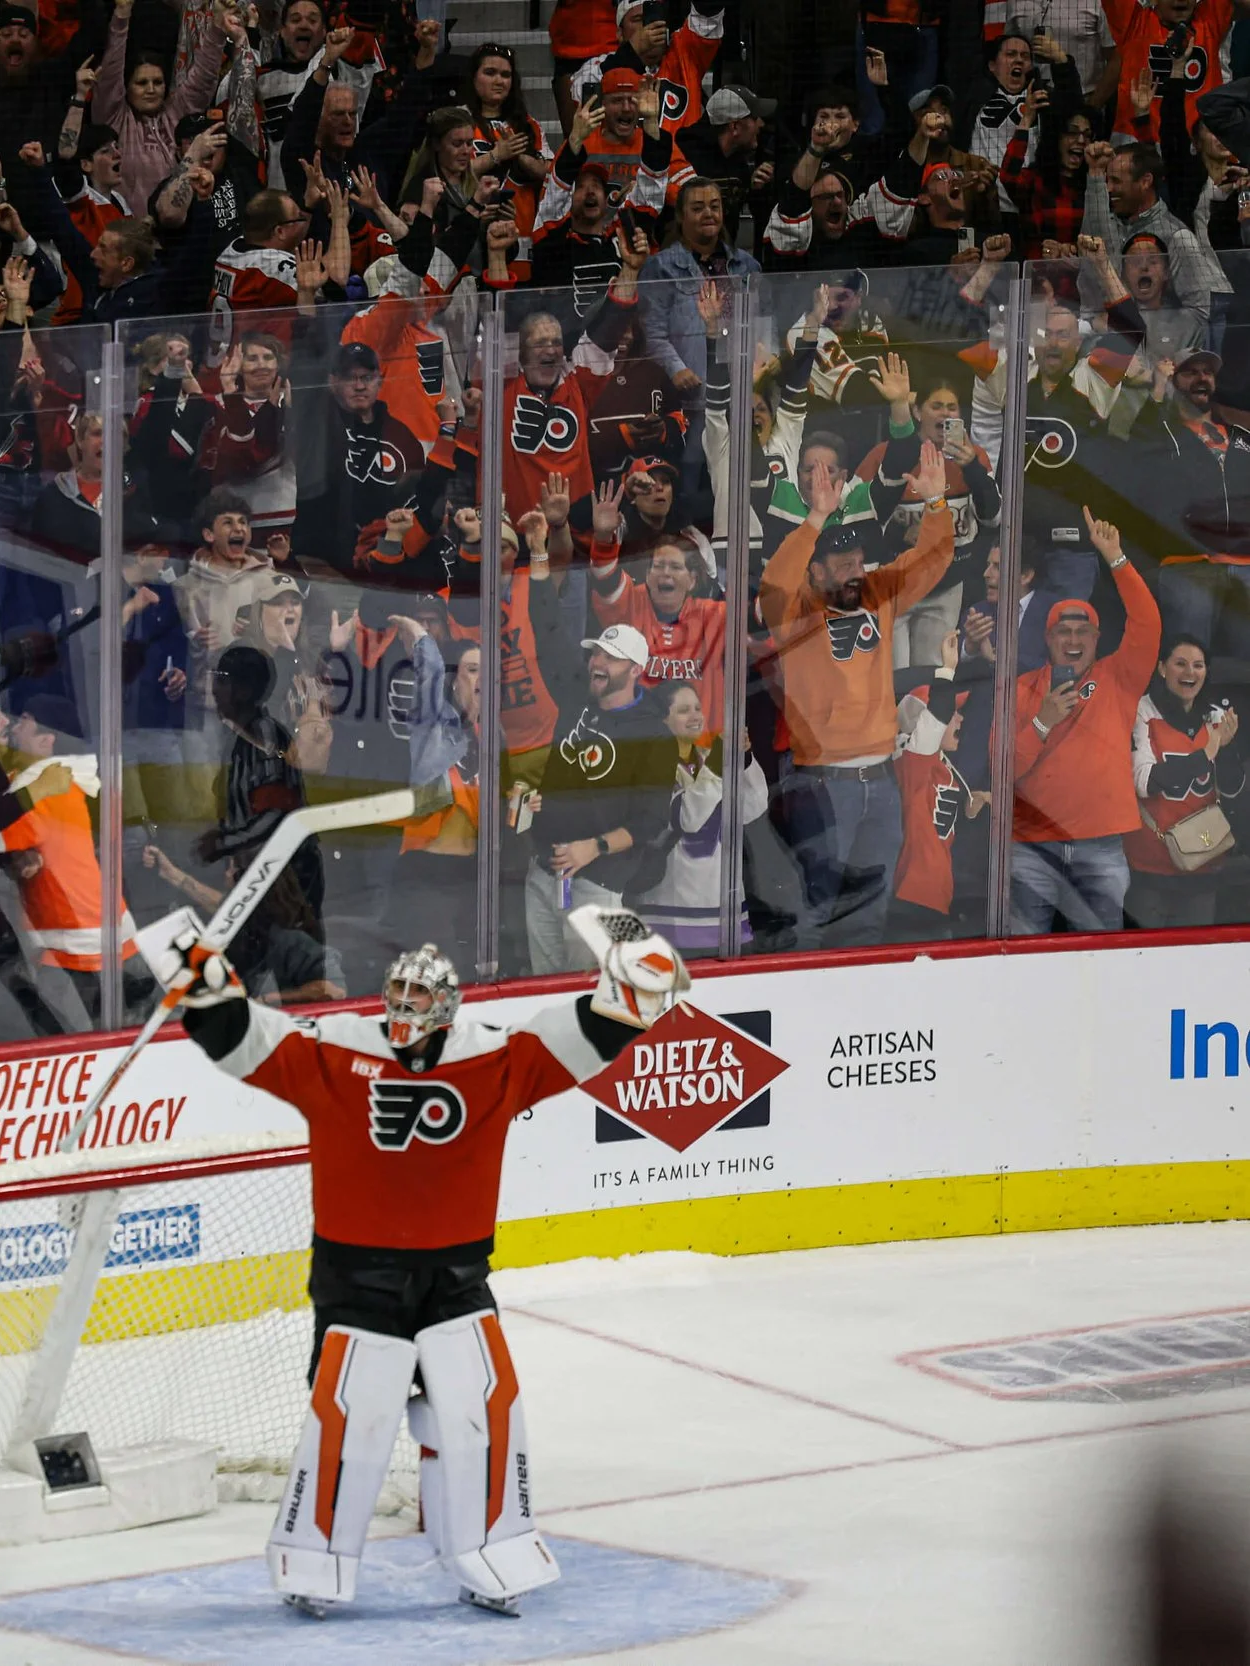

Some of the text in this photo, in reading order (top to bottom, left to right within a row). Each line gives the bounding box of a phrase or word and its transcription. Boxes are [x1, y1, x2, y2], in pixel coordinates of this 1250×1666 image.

[633, 1037, 743, 1078] DIETZ &
[830, 1029, 934, 1059] ARTISAN
[1170, 1008, 1250, 1080] In
[614, 1068, 746, 1113] WATSON
[827, 1059, 937, 1089] CHEESES
[593, 1155, 775, 1189] IT'S A FAMILY THING
[107, 1215, 193, 1253] GETHER
